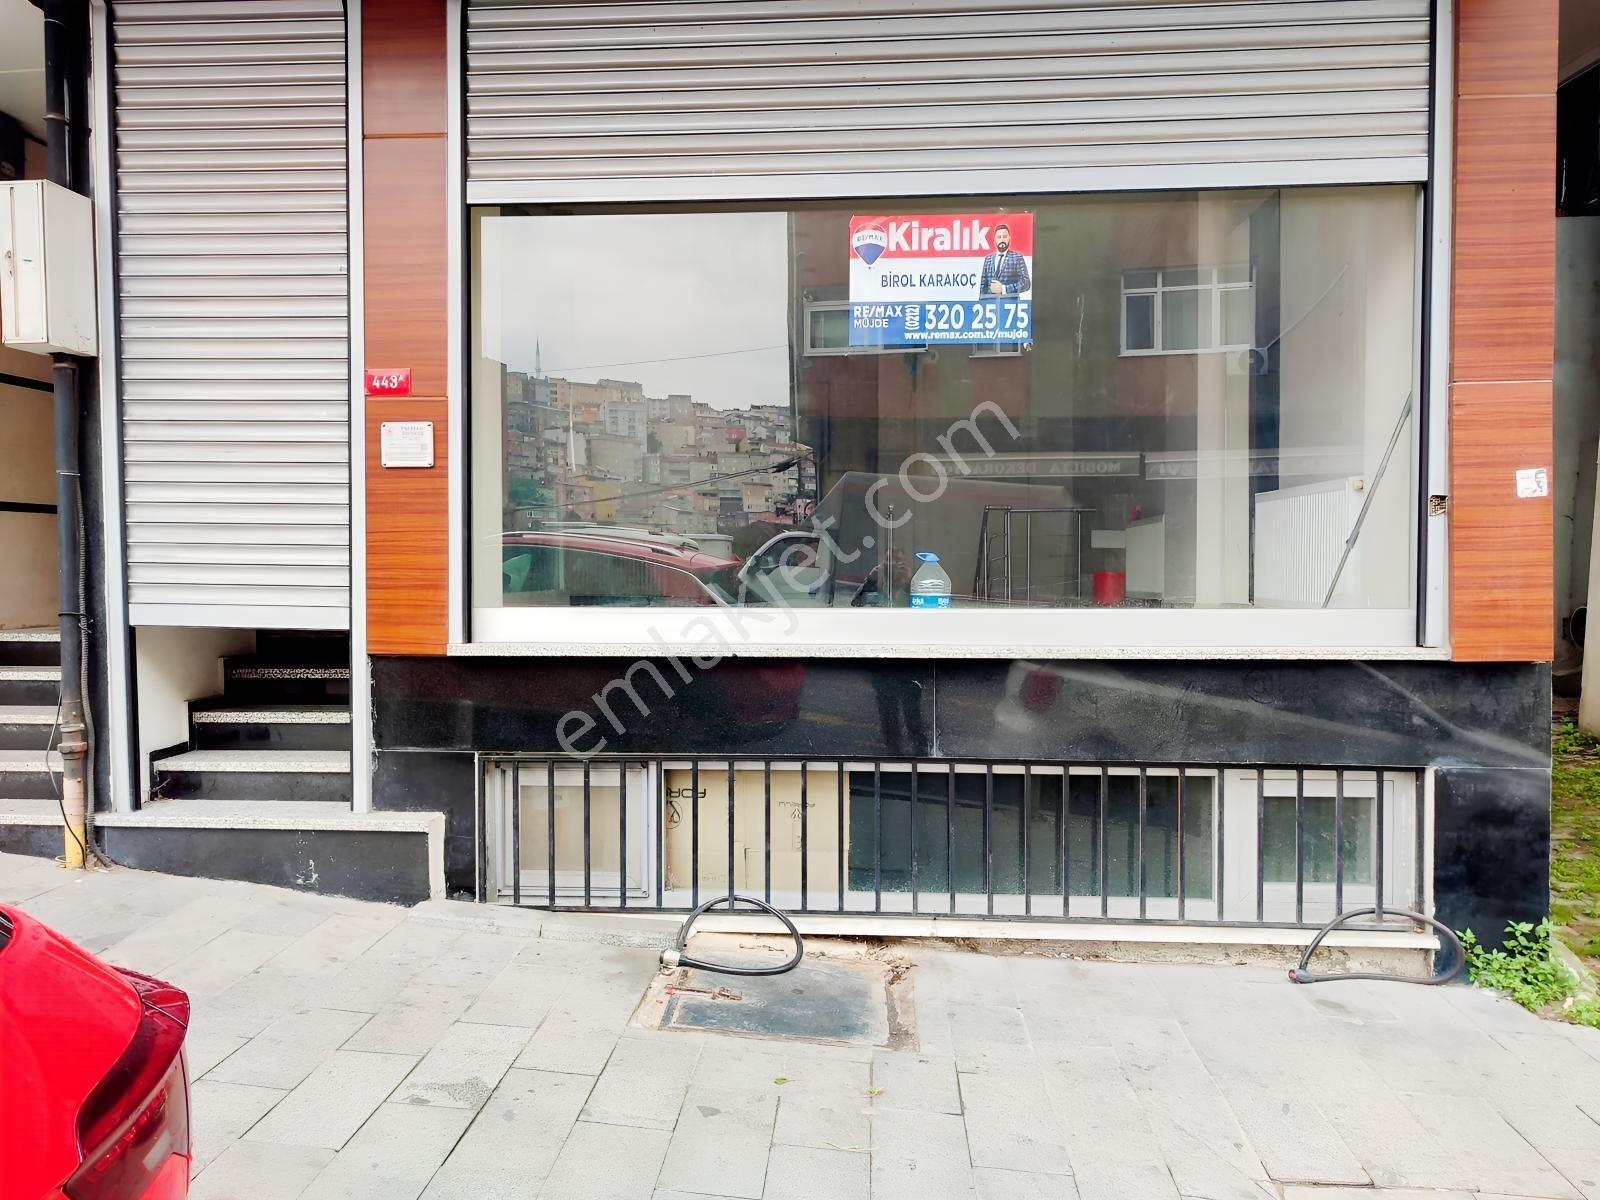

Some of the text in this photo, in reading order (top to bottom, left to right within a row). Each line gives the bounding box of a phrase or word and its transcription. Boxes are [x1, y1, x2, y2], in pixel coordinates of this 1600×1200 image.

[889, 220, 991, 251] Kiralık
[881, 271, 977, 288] BİROL KARAKOÇ
[853, 305, 903, 318] RE/MAX
[925, 303, 1029, 330] 320 25 75
[666, 788, 707, 799] FOR
